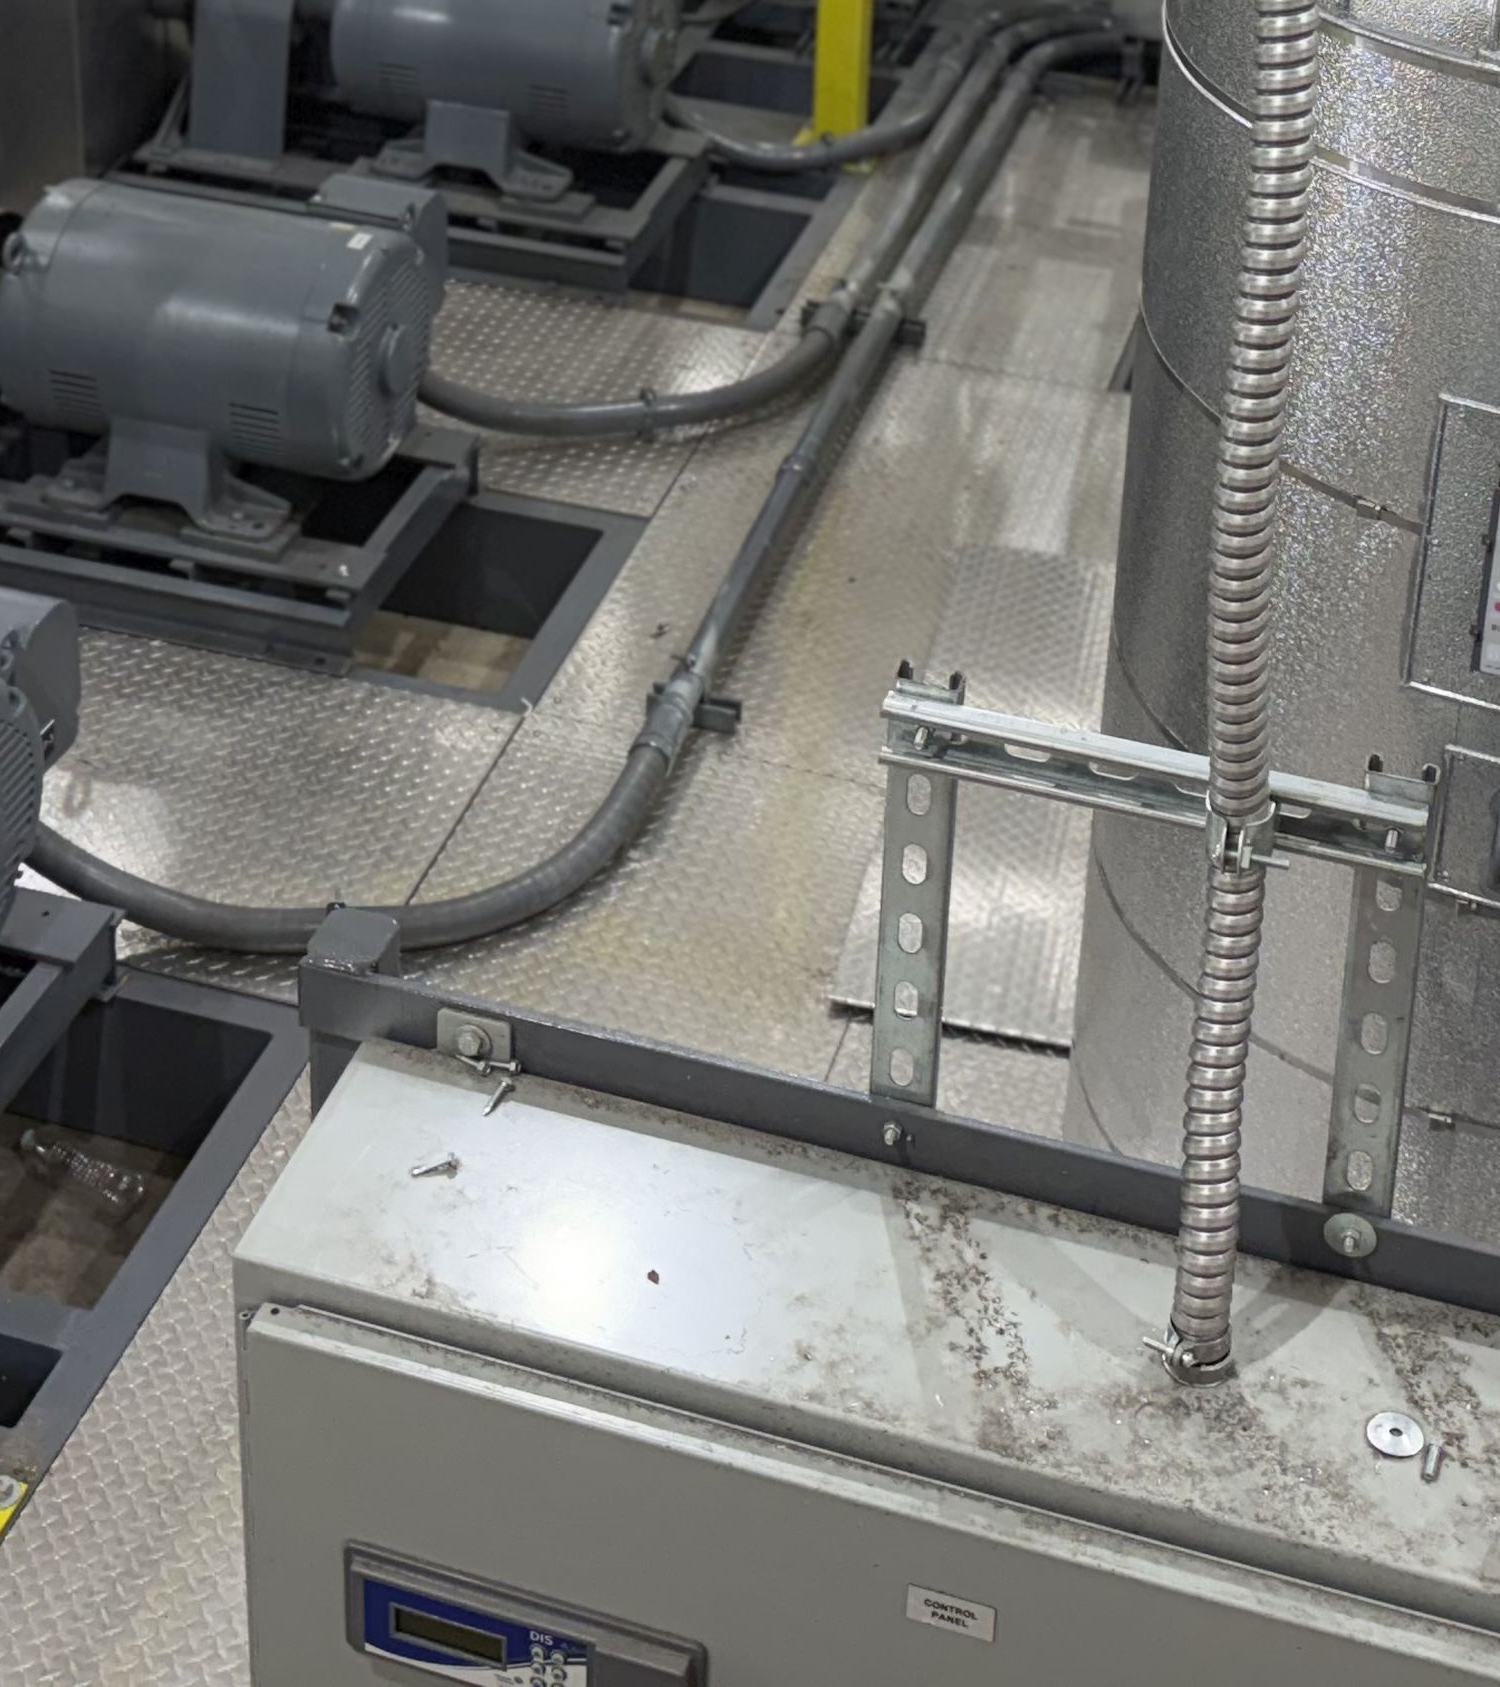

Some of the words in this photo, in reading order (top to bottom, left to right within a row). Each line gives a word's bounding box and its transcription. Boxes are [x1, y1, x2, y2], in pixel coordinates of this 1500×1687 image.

[923, 1598, 978, 1621] CONTROL
[931, 1610, 969, 1629] PANEL
[529, 1630, 554, 1647] DIS
